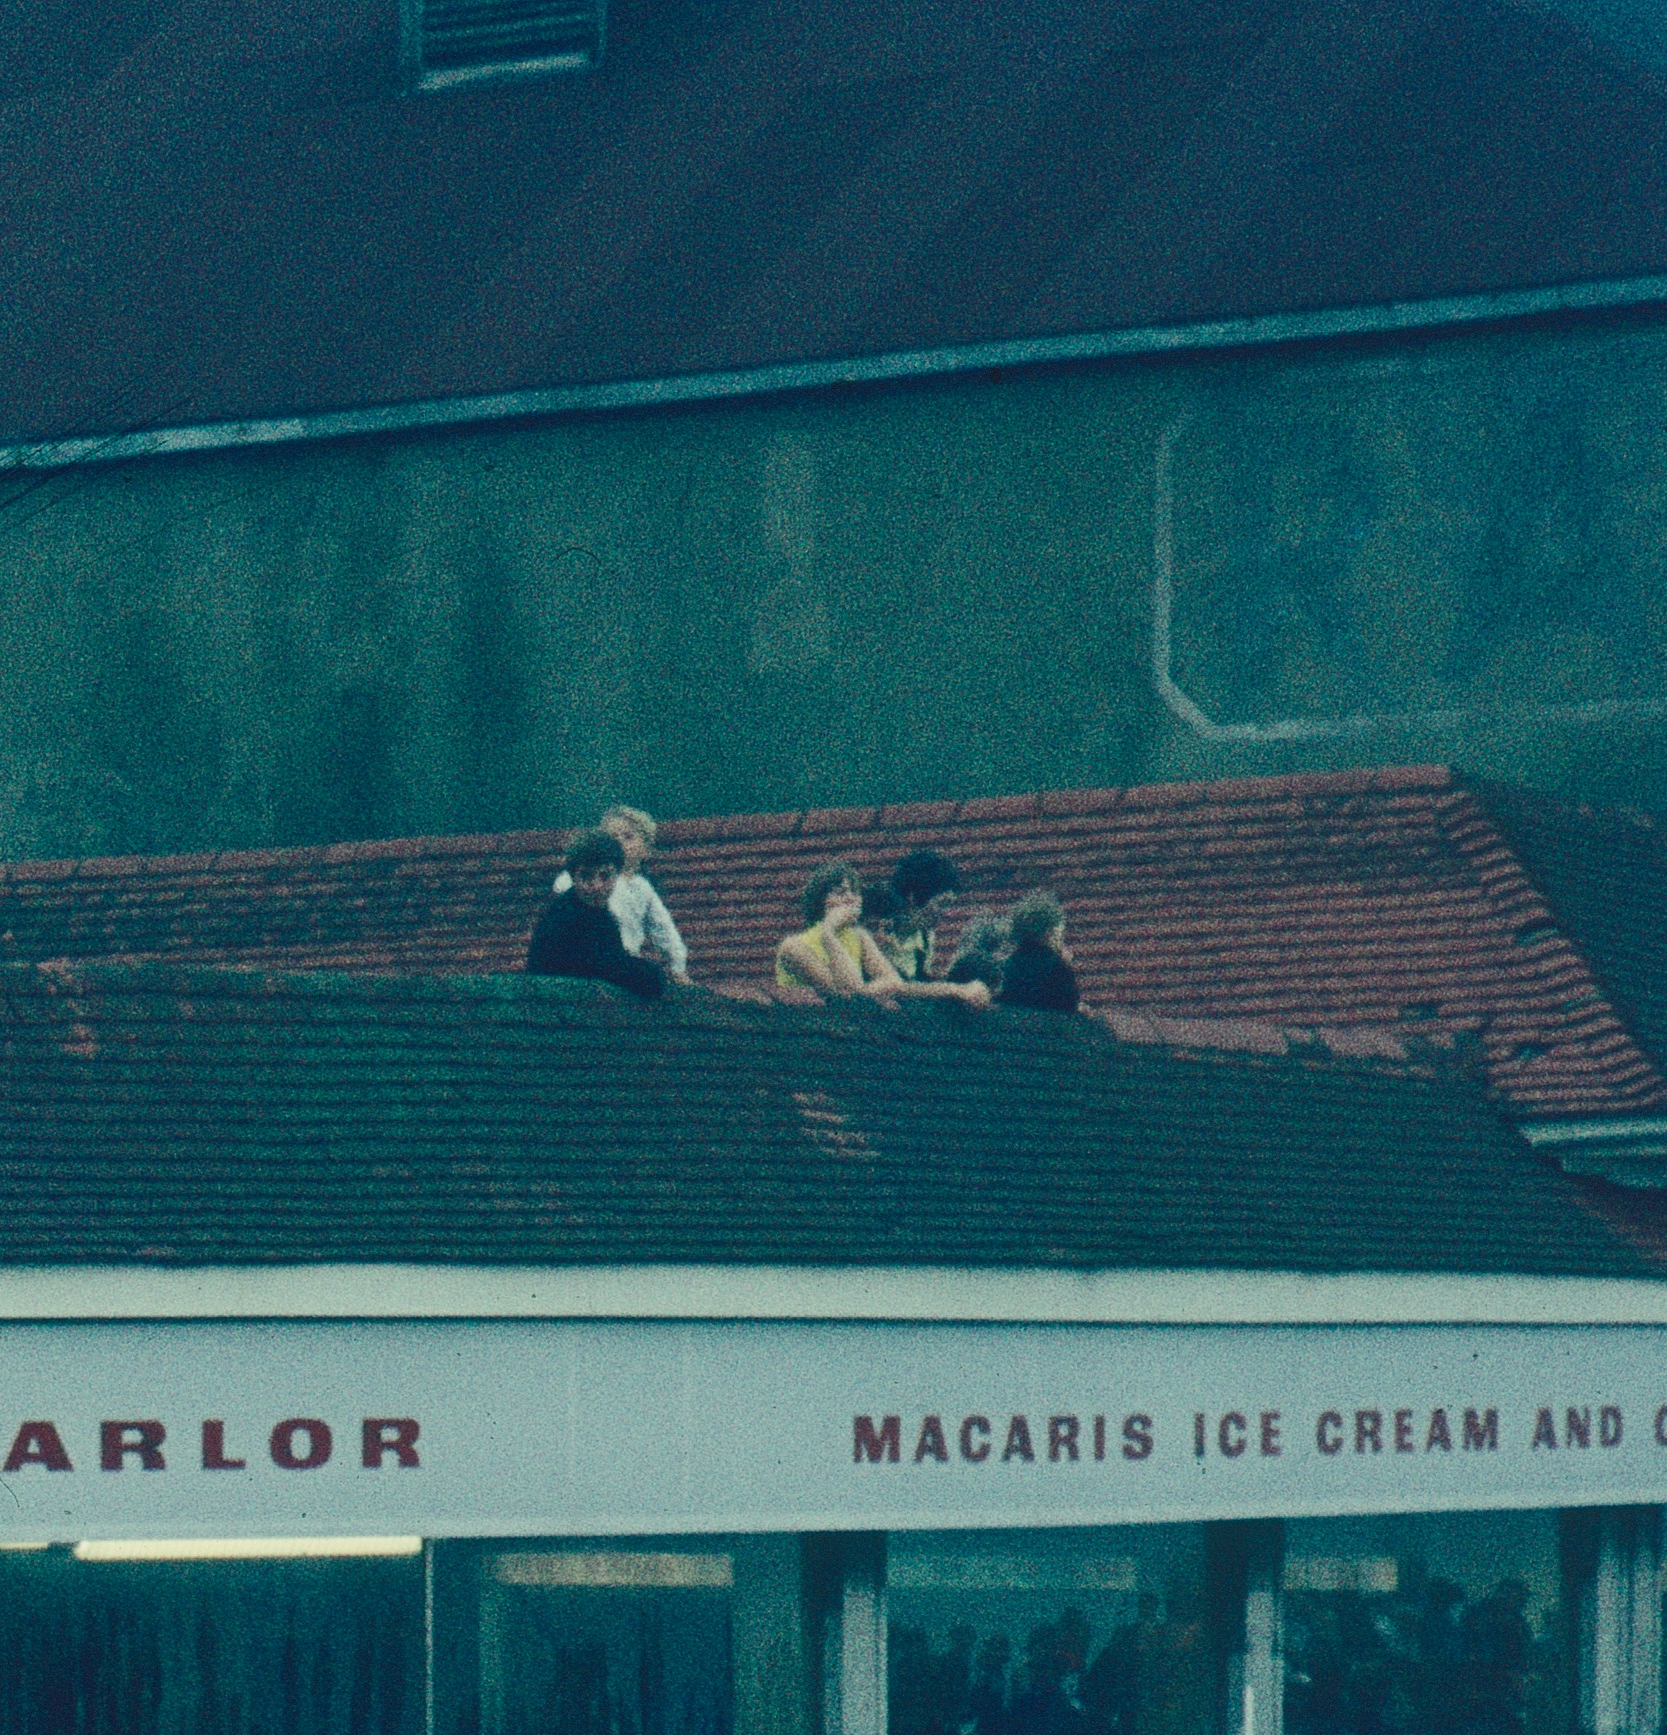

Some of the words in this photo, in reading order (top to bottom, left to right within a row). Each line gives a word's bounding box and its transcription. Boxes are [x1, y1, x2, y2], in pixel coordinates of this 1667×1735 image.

[852, 1412, 1155, 1464] MACARIS
[1194, 1410, 1283, 1459] ICE
[1315, 1405, 1501, 1457] CREAM
[1531, 1404, 1624, 1450] AND
